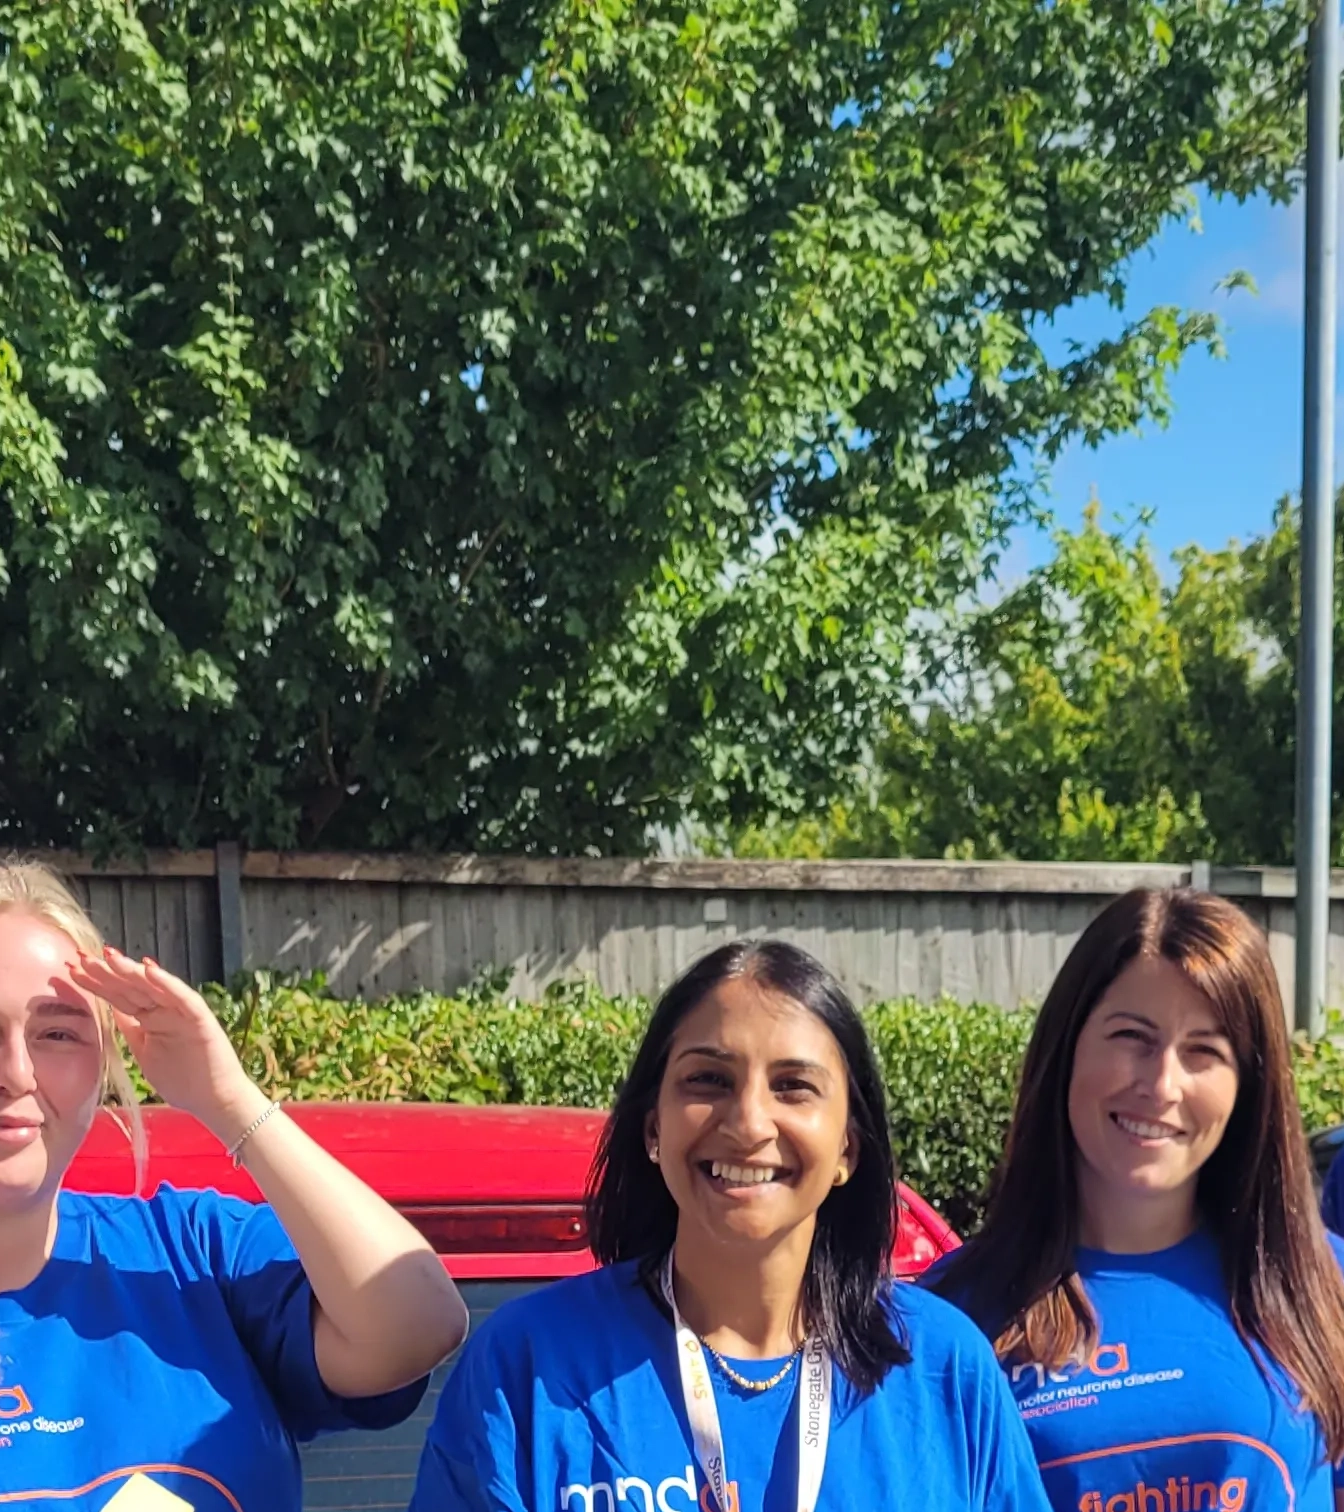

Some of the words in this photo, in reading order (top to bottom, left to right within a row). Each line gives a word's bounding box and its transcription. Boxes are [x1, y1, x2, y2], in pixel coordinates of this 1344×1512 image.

[1057, 1379, 1123, 1399] neurone
[1124, 1368, 1185, 1387] disease
[805, 1366, 825, 1448] Stonegate
[1020, 1395, 1099, 1420] ssociation
[32, 1415, 85, 1433] disease
